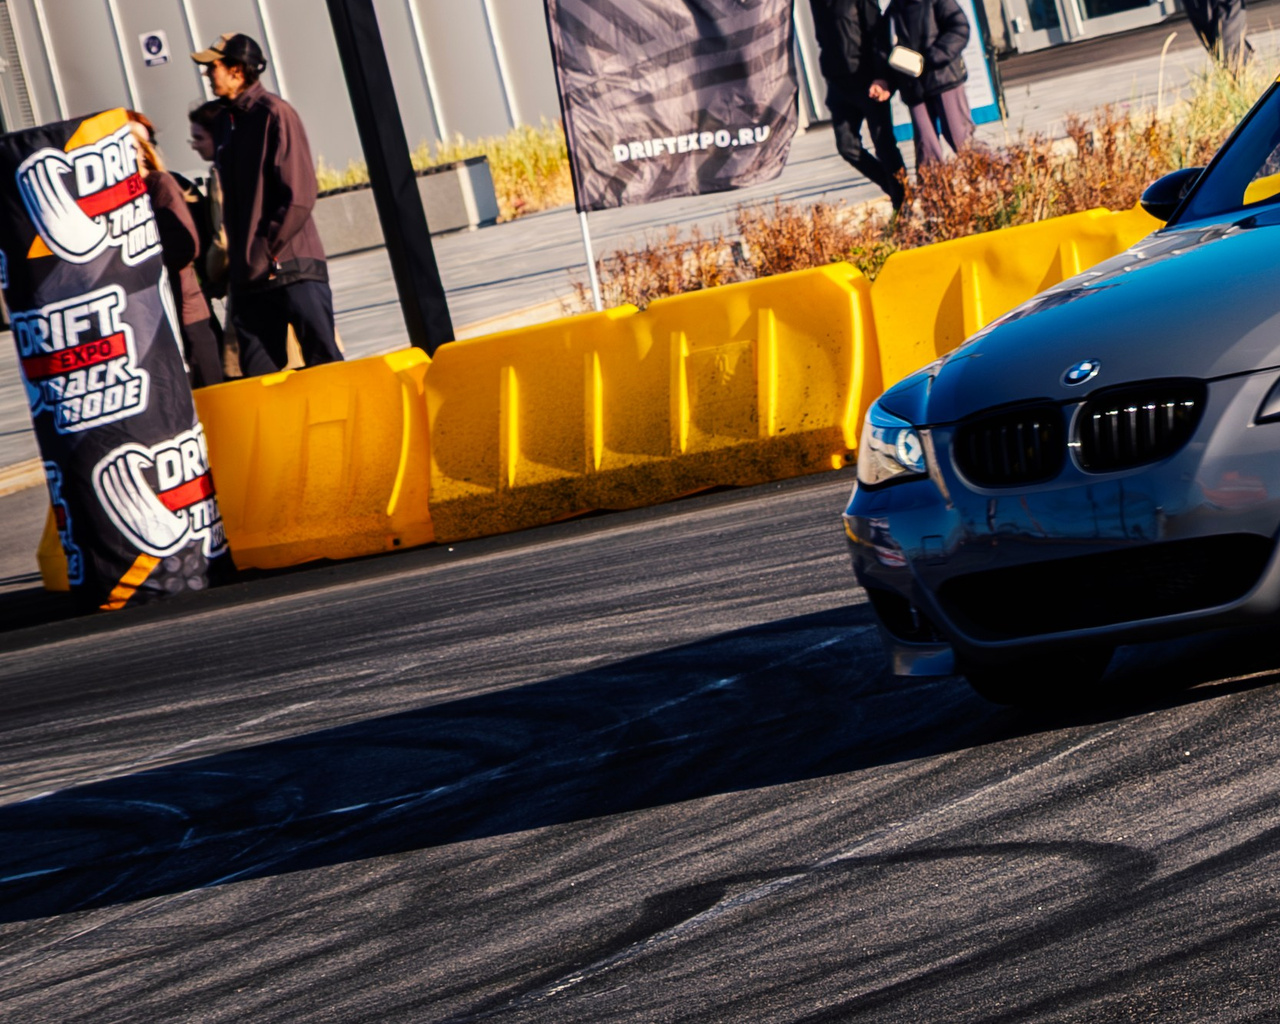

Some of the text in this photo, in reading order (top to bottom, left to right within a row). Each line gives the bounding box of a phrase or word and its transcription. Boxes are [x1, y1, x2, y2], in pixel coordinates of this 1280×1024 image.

[612, 125, 771, 163] DRIFTEXPO.RU
[15, 293, 119, 358] DRIFT
[59, 339, 112, 369] EXPO
